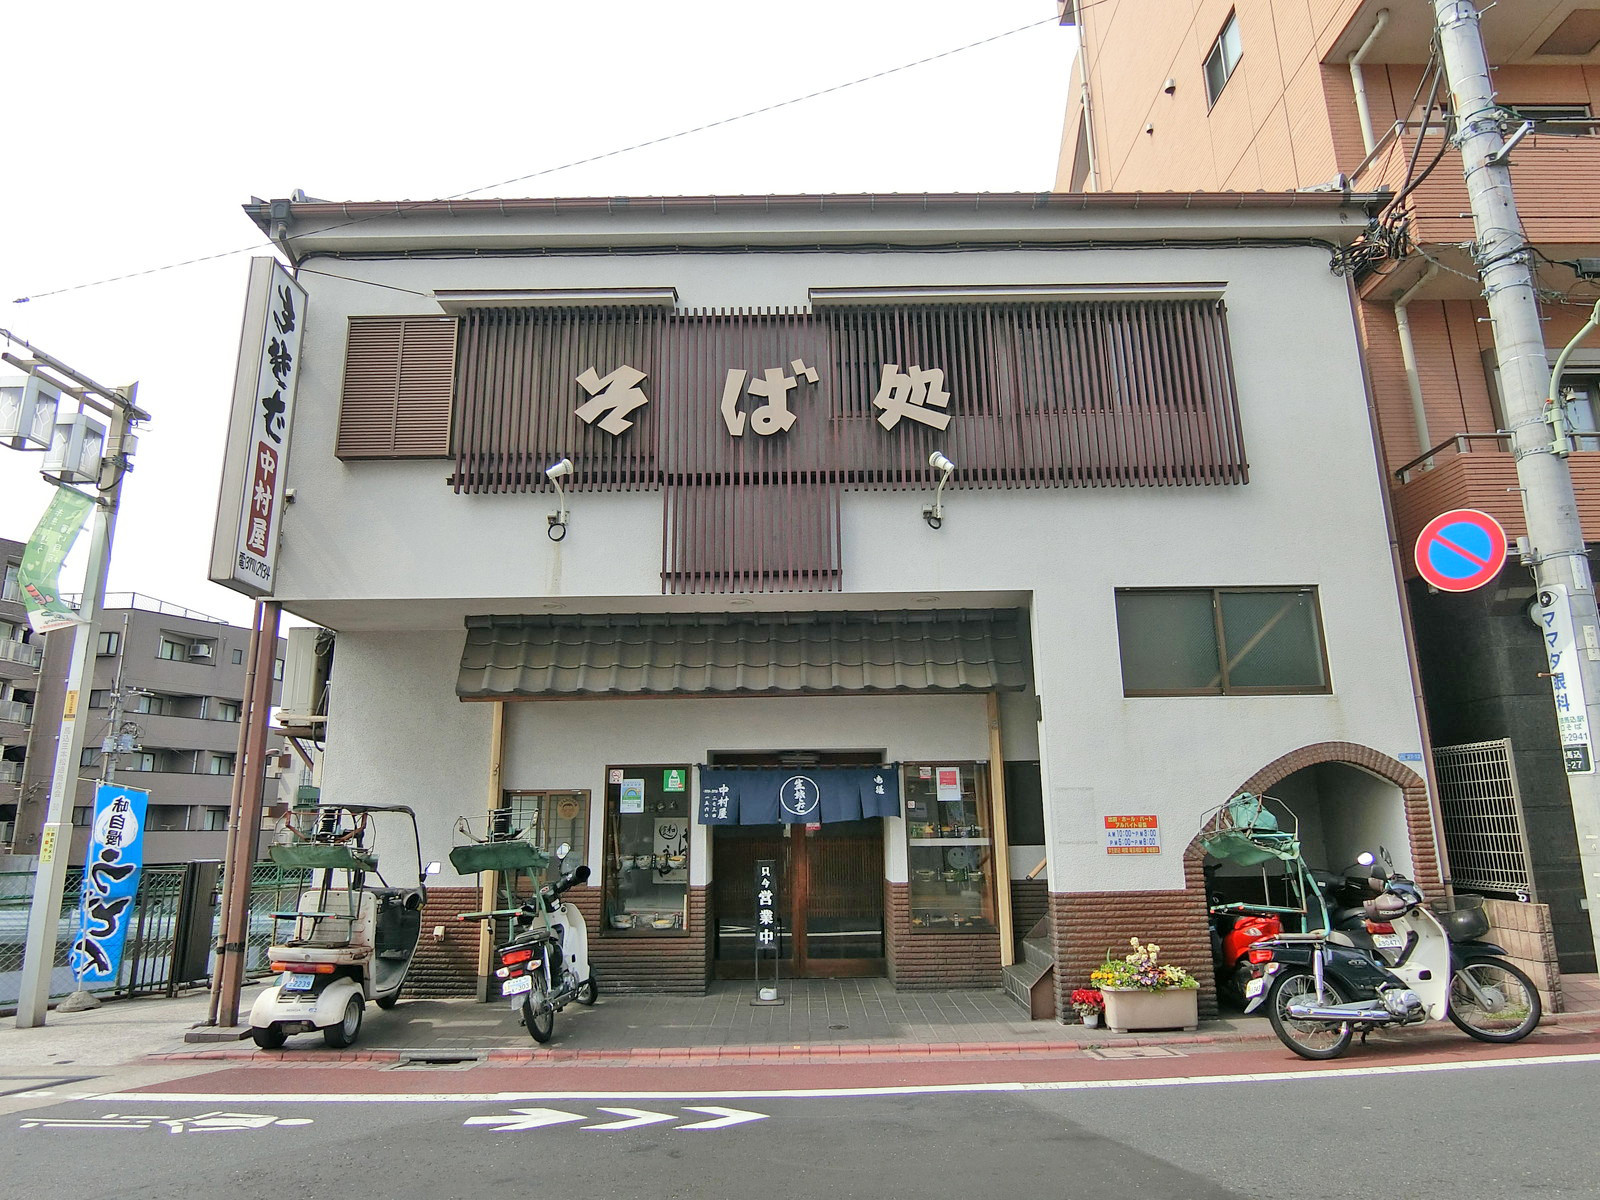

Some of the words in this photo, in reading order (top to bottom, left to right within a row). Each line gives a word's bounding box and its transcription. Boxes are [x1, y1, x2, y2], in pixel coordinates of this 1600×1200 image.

[574, 359, 951, 436] そば処
[247, 450, 276, 551] 中村屋
[1542, 611, 1571, 712] ママダ眼科
[717, 783, 730, 819] 中村屋
[758, 866, 774, 945] 只今営業中
